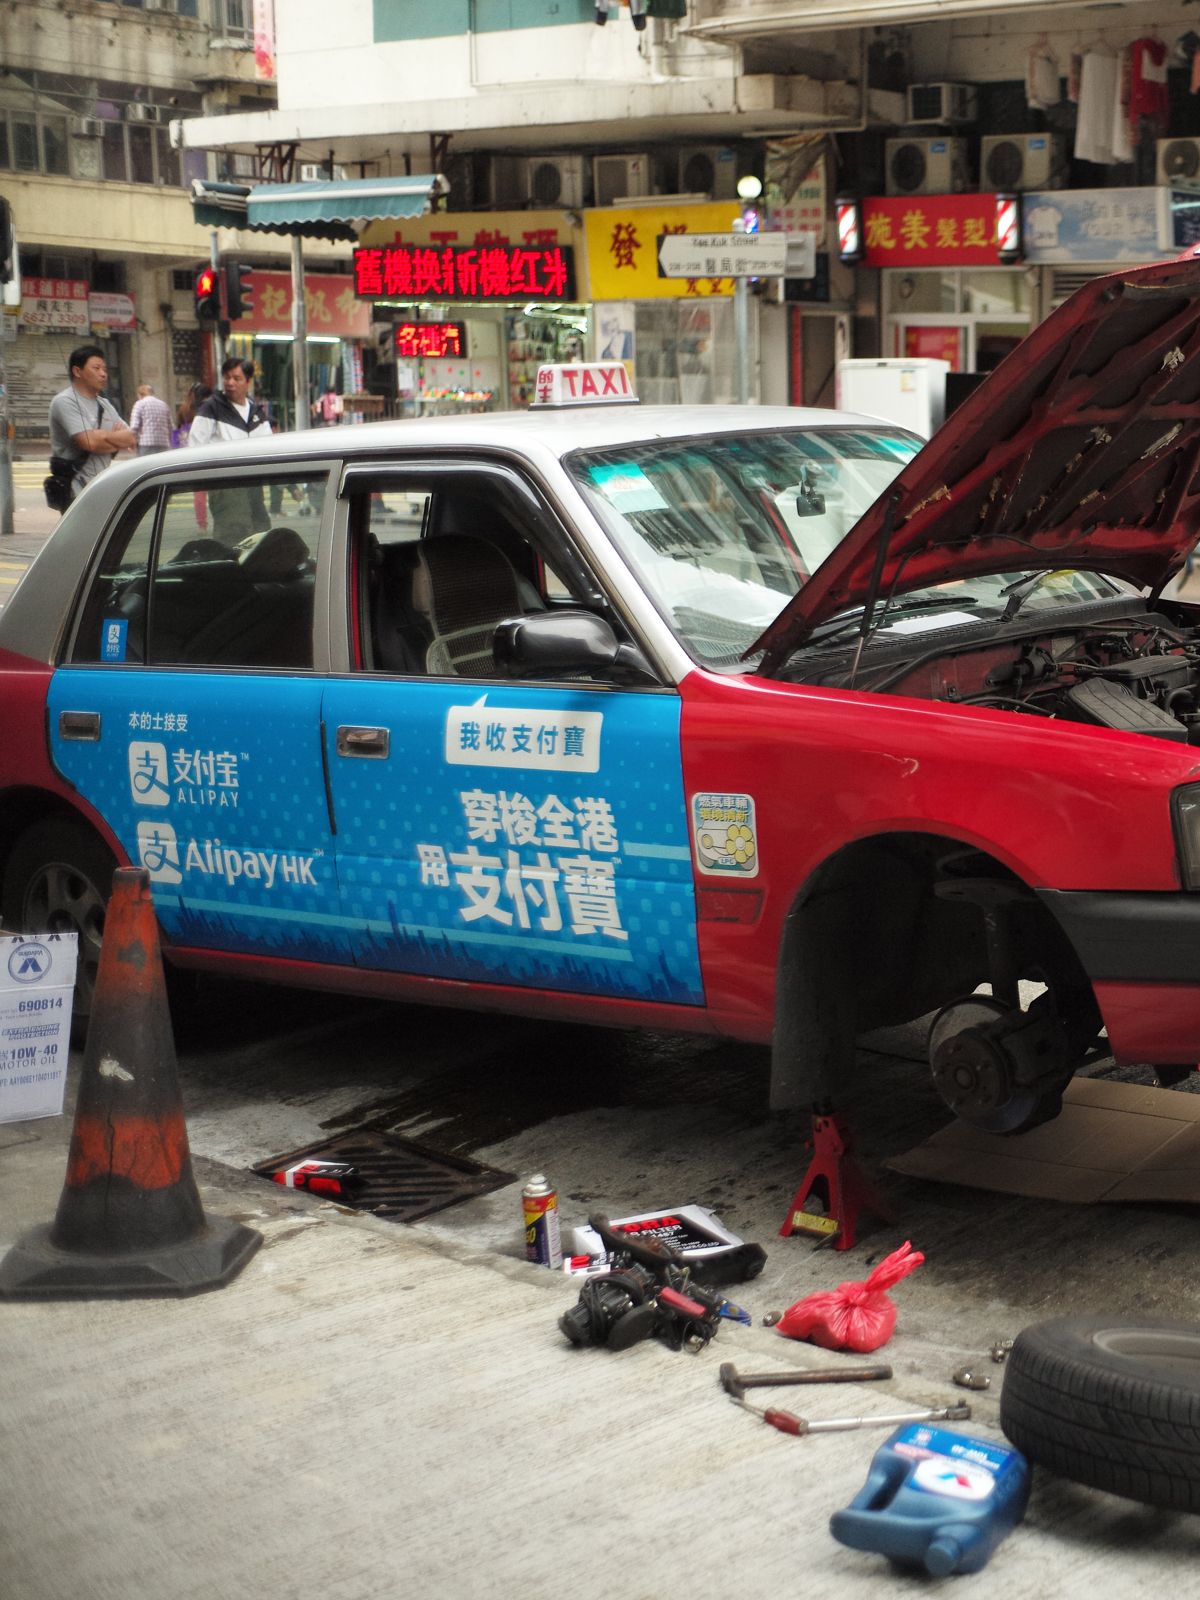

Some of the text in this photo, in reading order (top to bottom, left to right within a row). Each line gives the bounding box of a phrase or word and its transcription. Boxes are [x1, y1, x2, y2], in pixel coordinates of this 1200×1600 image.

[866, 209, 999, 249] 施美髮型
[538, 369, 554, 404] 的士
[562, 367, 628, 397] TAXI
[128, 711, 188, 733] 本的士接受
[459, 721, 586, 757] 我收支付寶
[172, 748, 240, 788] 支付宝
[178, 787, 239, 808] ALIPAY
[460, 788, 619, 853] 穿梭全港
[18, 997, 63, 1013] 690814
[10, 1043, 58, 1060] 10W-40
[40, 1055, 57, 1065] OIL
